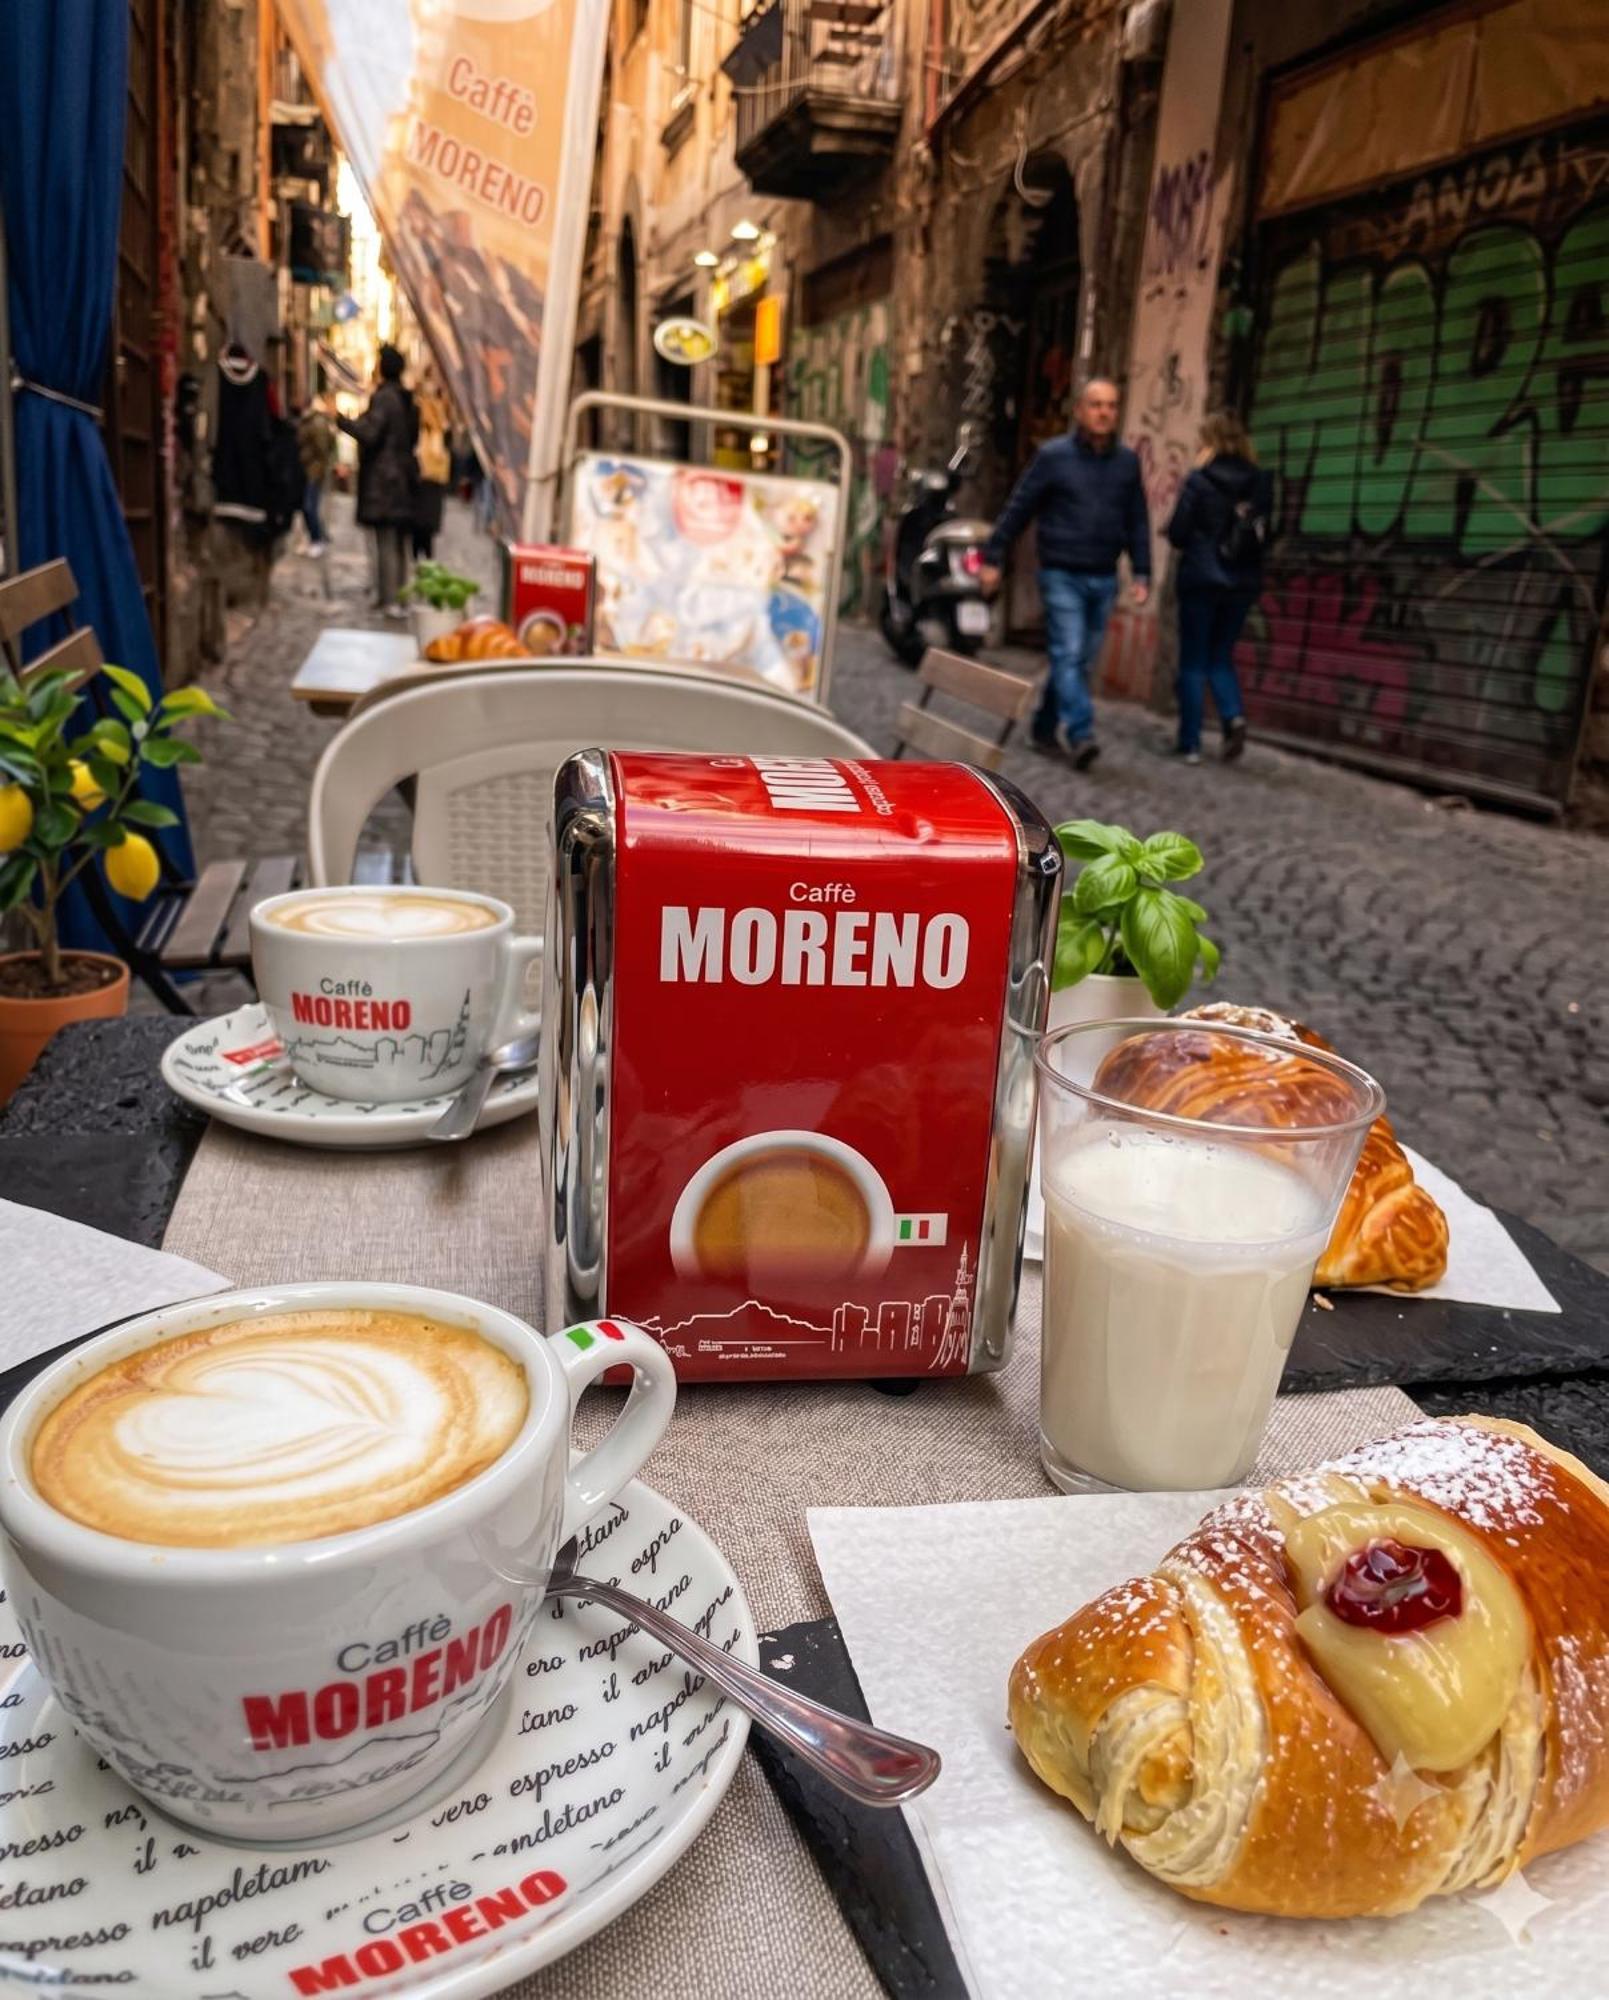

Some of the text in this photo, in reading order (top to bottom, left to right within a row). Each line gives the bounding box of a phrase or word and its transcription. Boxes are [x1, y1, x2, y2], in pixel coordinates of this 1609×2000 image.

[449, 57, 534, 134] Caffè
[412, 120, 545, 225] MORENO
[790, 882, 856, 903] Caffè
[660, 906, 970, 989] MORENO
[292, 991, 411, 1031] MORENO
[320, 977, 373, 996] Caffè
[337, 1613, 451, 1673] Caffè
[243, 1603, 512, 1752] MORENO
[602, 1673, 620, 1702] il
[510, 1741, 617, 1803] espresso
[654, 1741, 673, 1772] il
[134, 1837, 157, 1874] il
[288, 1870, 568, 1997] MORENO
[363, 1879, 472, 1935] Caffè
[191, 1936, 215, 1971] il
